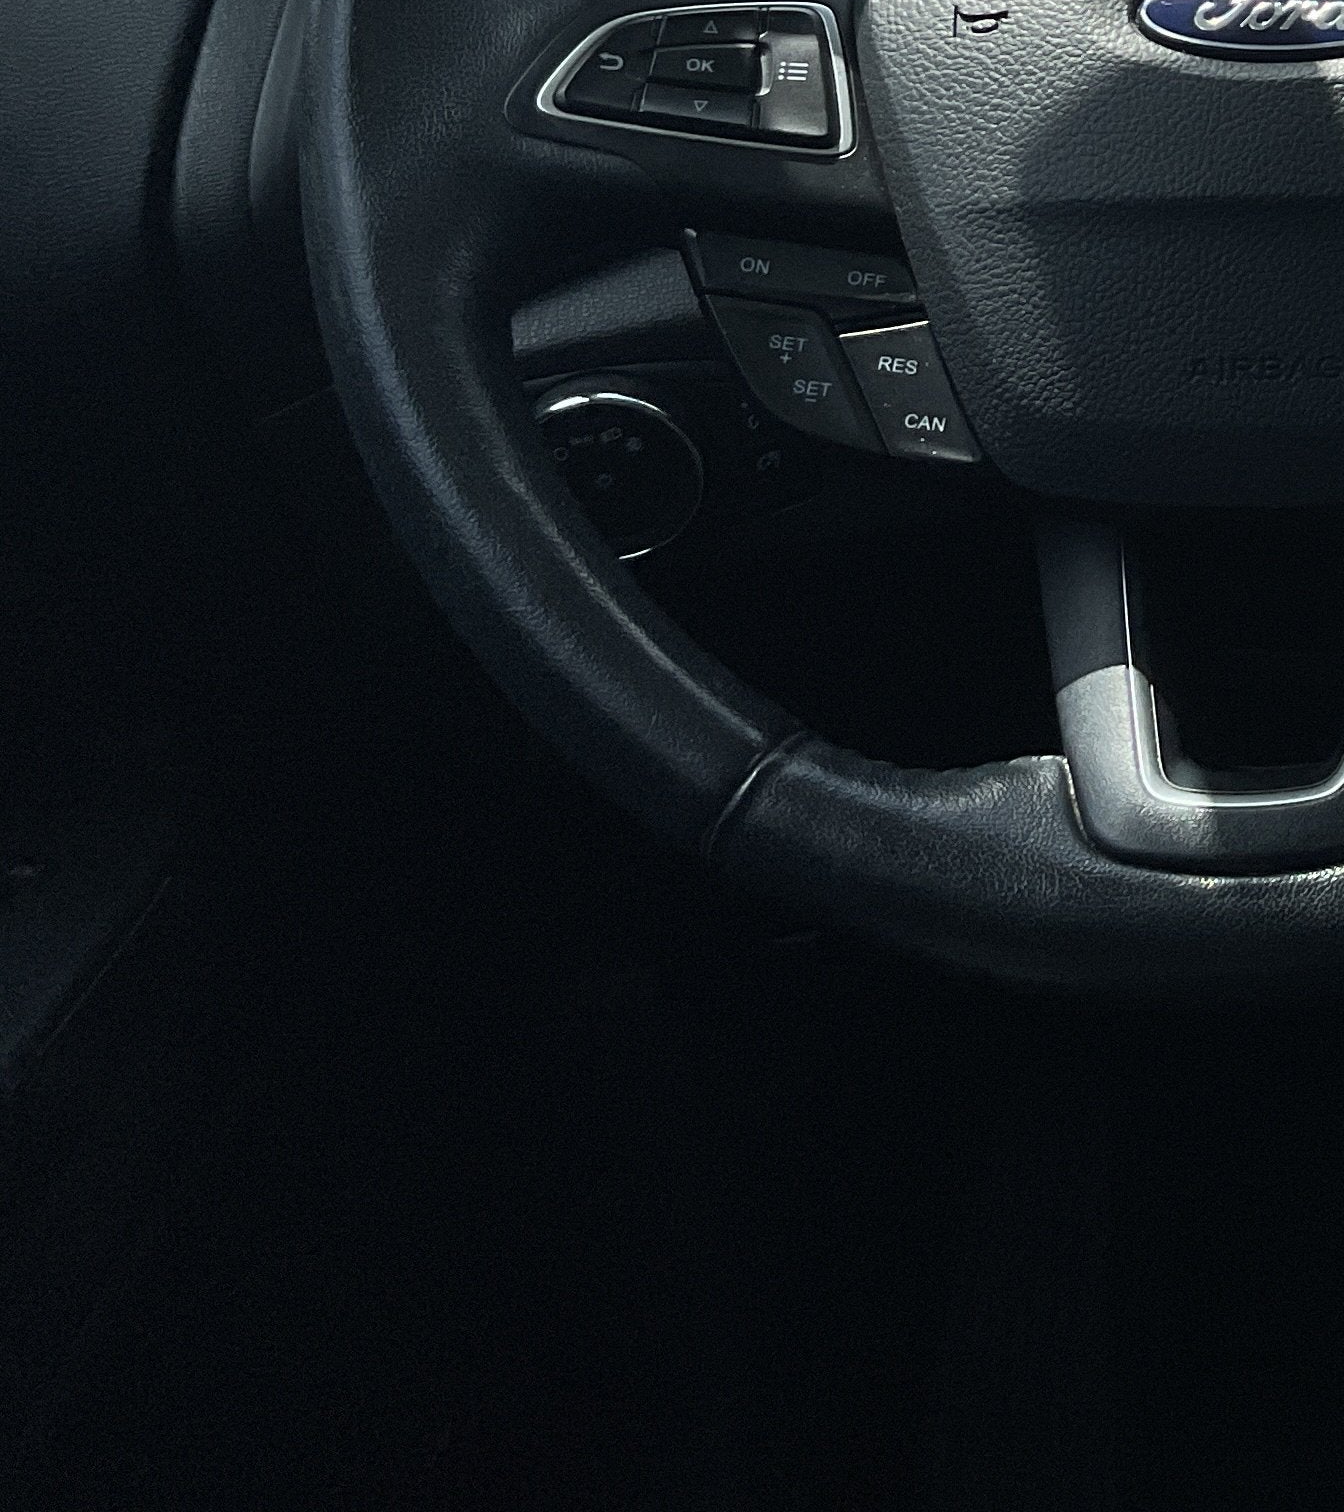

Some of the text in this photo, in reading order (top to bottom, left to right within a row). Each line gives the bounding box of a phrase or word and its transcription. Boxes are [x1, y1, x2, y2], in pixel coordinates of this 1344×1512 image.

[686, 58, 714, 74] OK
[740, 256, 770, 275] ON
[847, 270, 886, 288] OFF
[769, 335, 808, 352] SET
[878, 356, 918, 376] RES
[793, 379, 831, 398] SET
[904, 414, 946, 433] CAN
